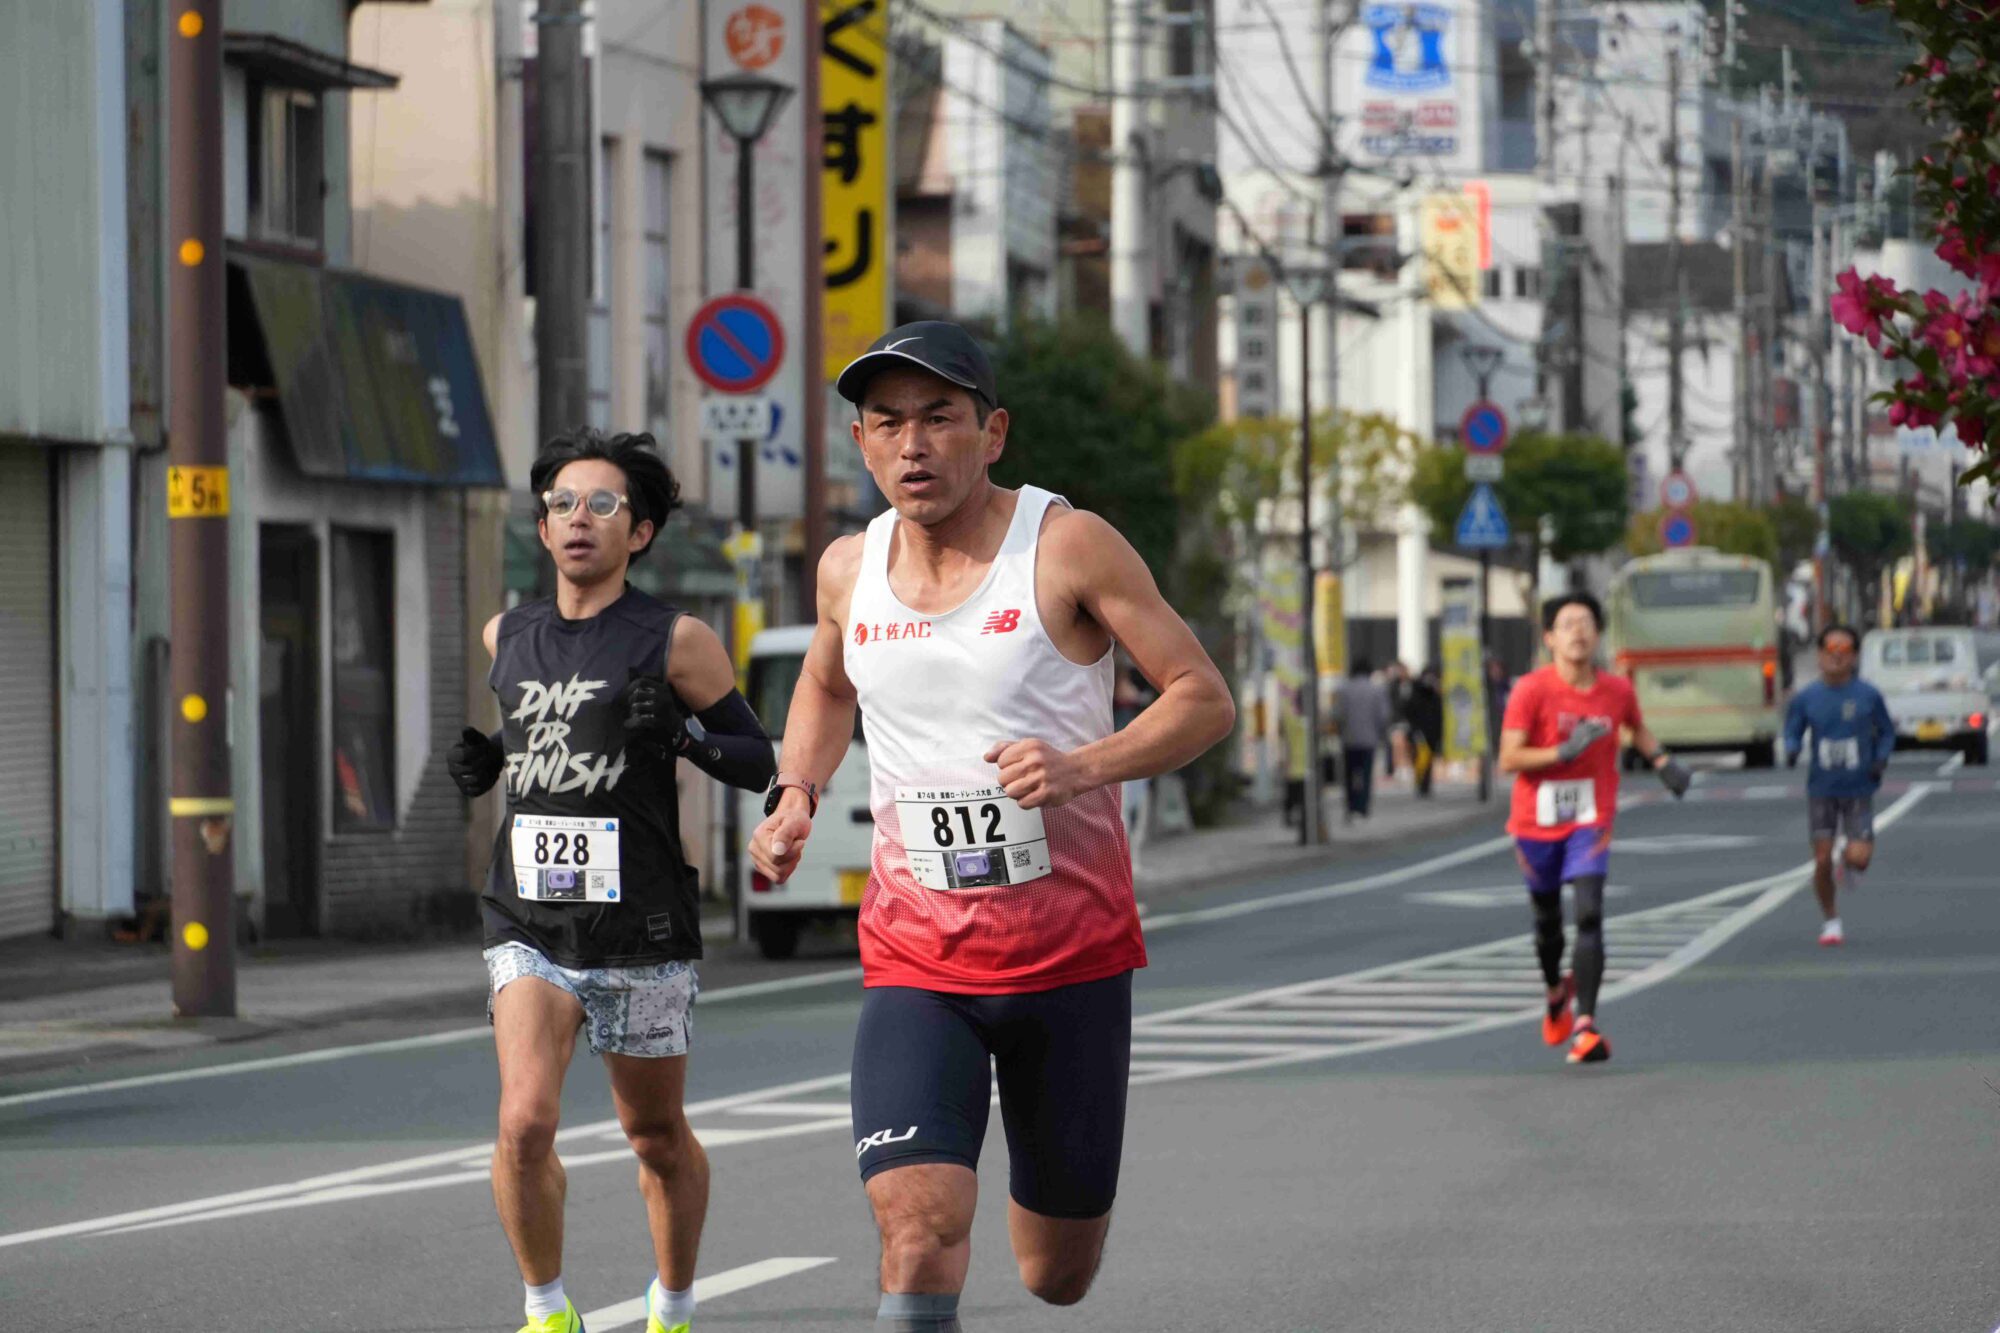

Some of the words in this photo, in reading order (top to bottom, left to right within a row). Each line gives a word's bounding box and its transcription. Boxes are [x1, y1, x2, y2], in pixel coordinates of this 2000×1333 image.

[822, 0, 877, 287] くすり
[870, 621, 932, 642] 土佐AC
[508, 672, 610, 725] DNF
[525, 718, 571, 756] OR
[504, 745, 629, 799] FINISH
[931, 803, 1006, 847] 812
[535, 832, 590, 866] 828
